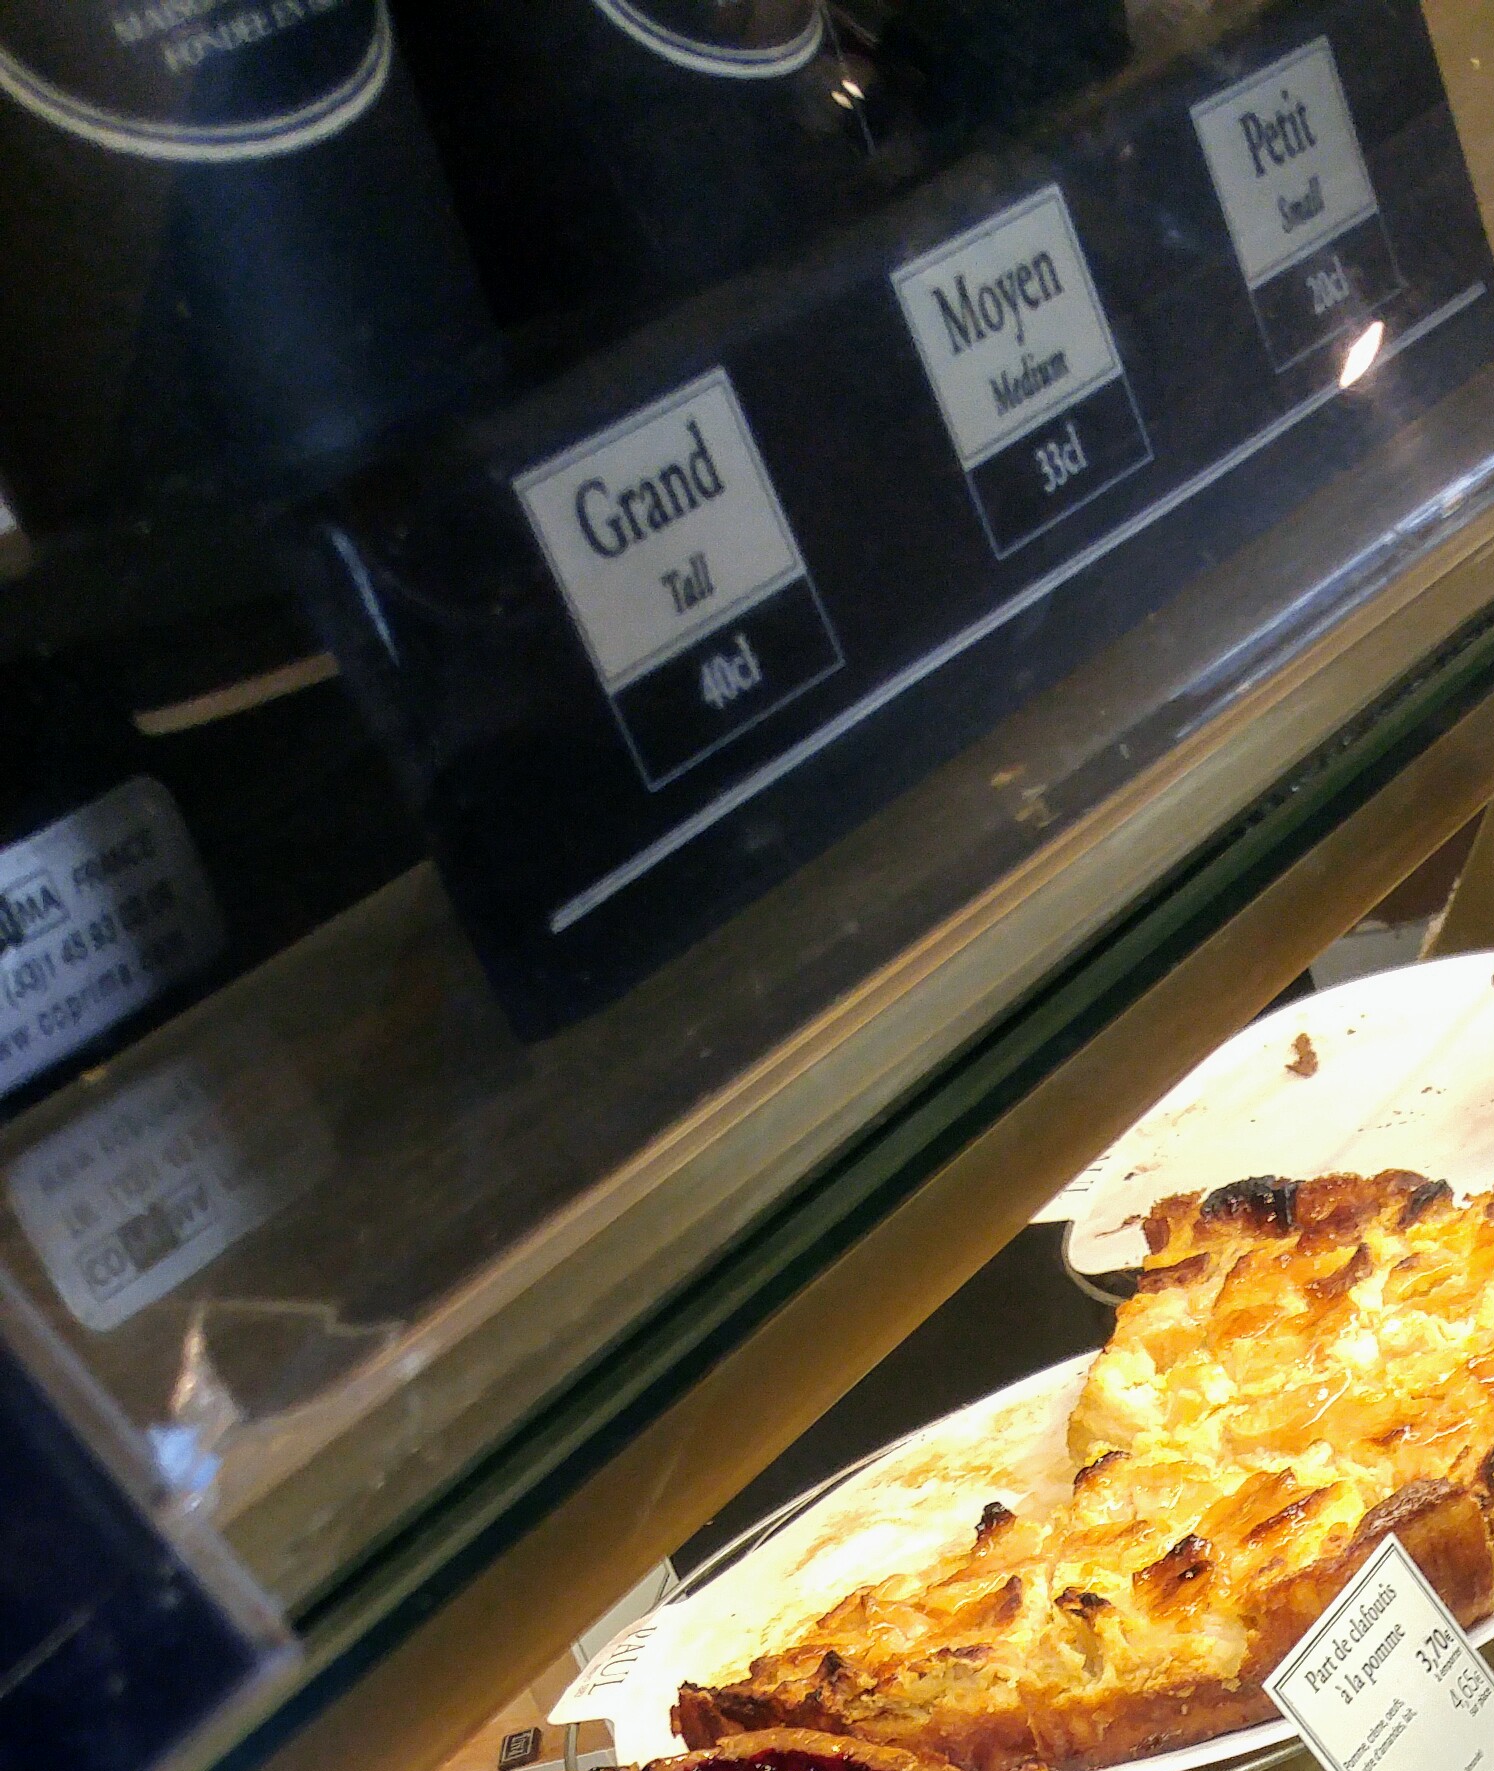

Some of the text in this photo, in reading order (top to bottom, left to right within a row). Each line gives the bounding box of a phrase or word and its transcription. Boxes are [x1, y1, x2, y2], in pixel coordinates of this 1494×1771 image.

[1239, 90, 1318, 179] Petit
[931, 250, 1066, 356] Moyen
[989, 350, 1070, 417] Medium
[575, 418, 725, 558] Grand
[1035, 421, 1089, 494] 33cl
[661, 551, 716, 615] Tall
[1304, 1583, 1397, 1693] Part de clafoutis
[1334, 1623, 1405, 1705] à la pomme
[1414, 1628, 1454, 1673] 3,70€
[1439, 1646, 1461, 1677] emporter
[1449, 1668, 1483, 1709] 4,65€
